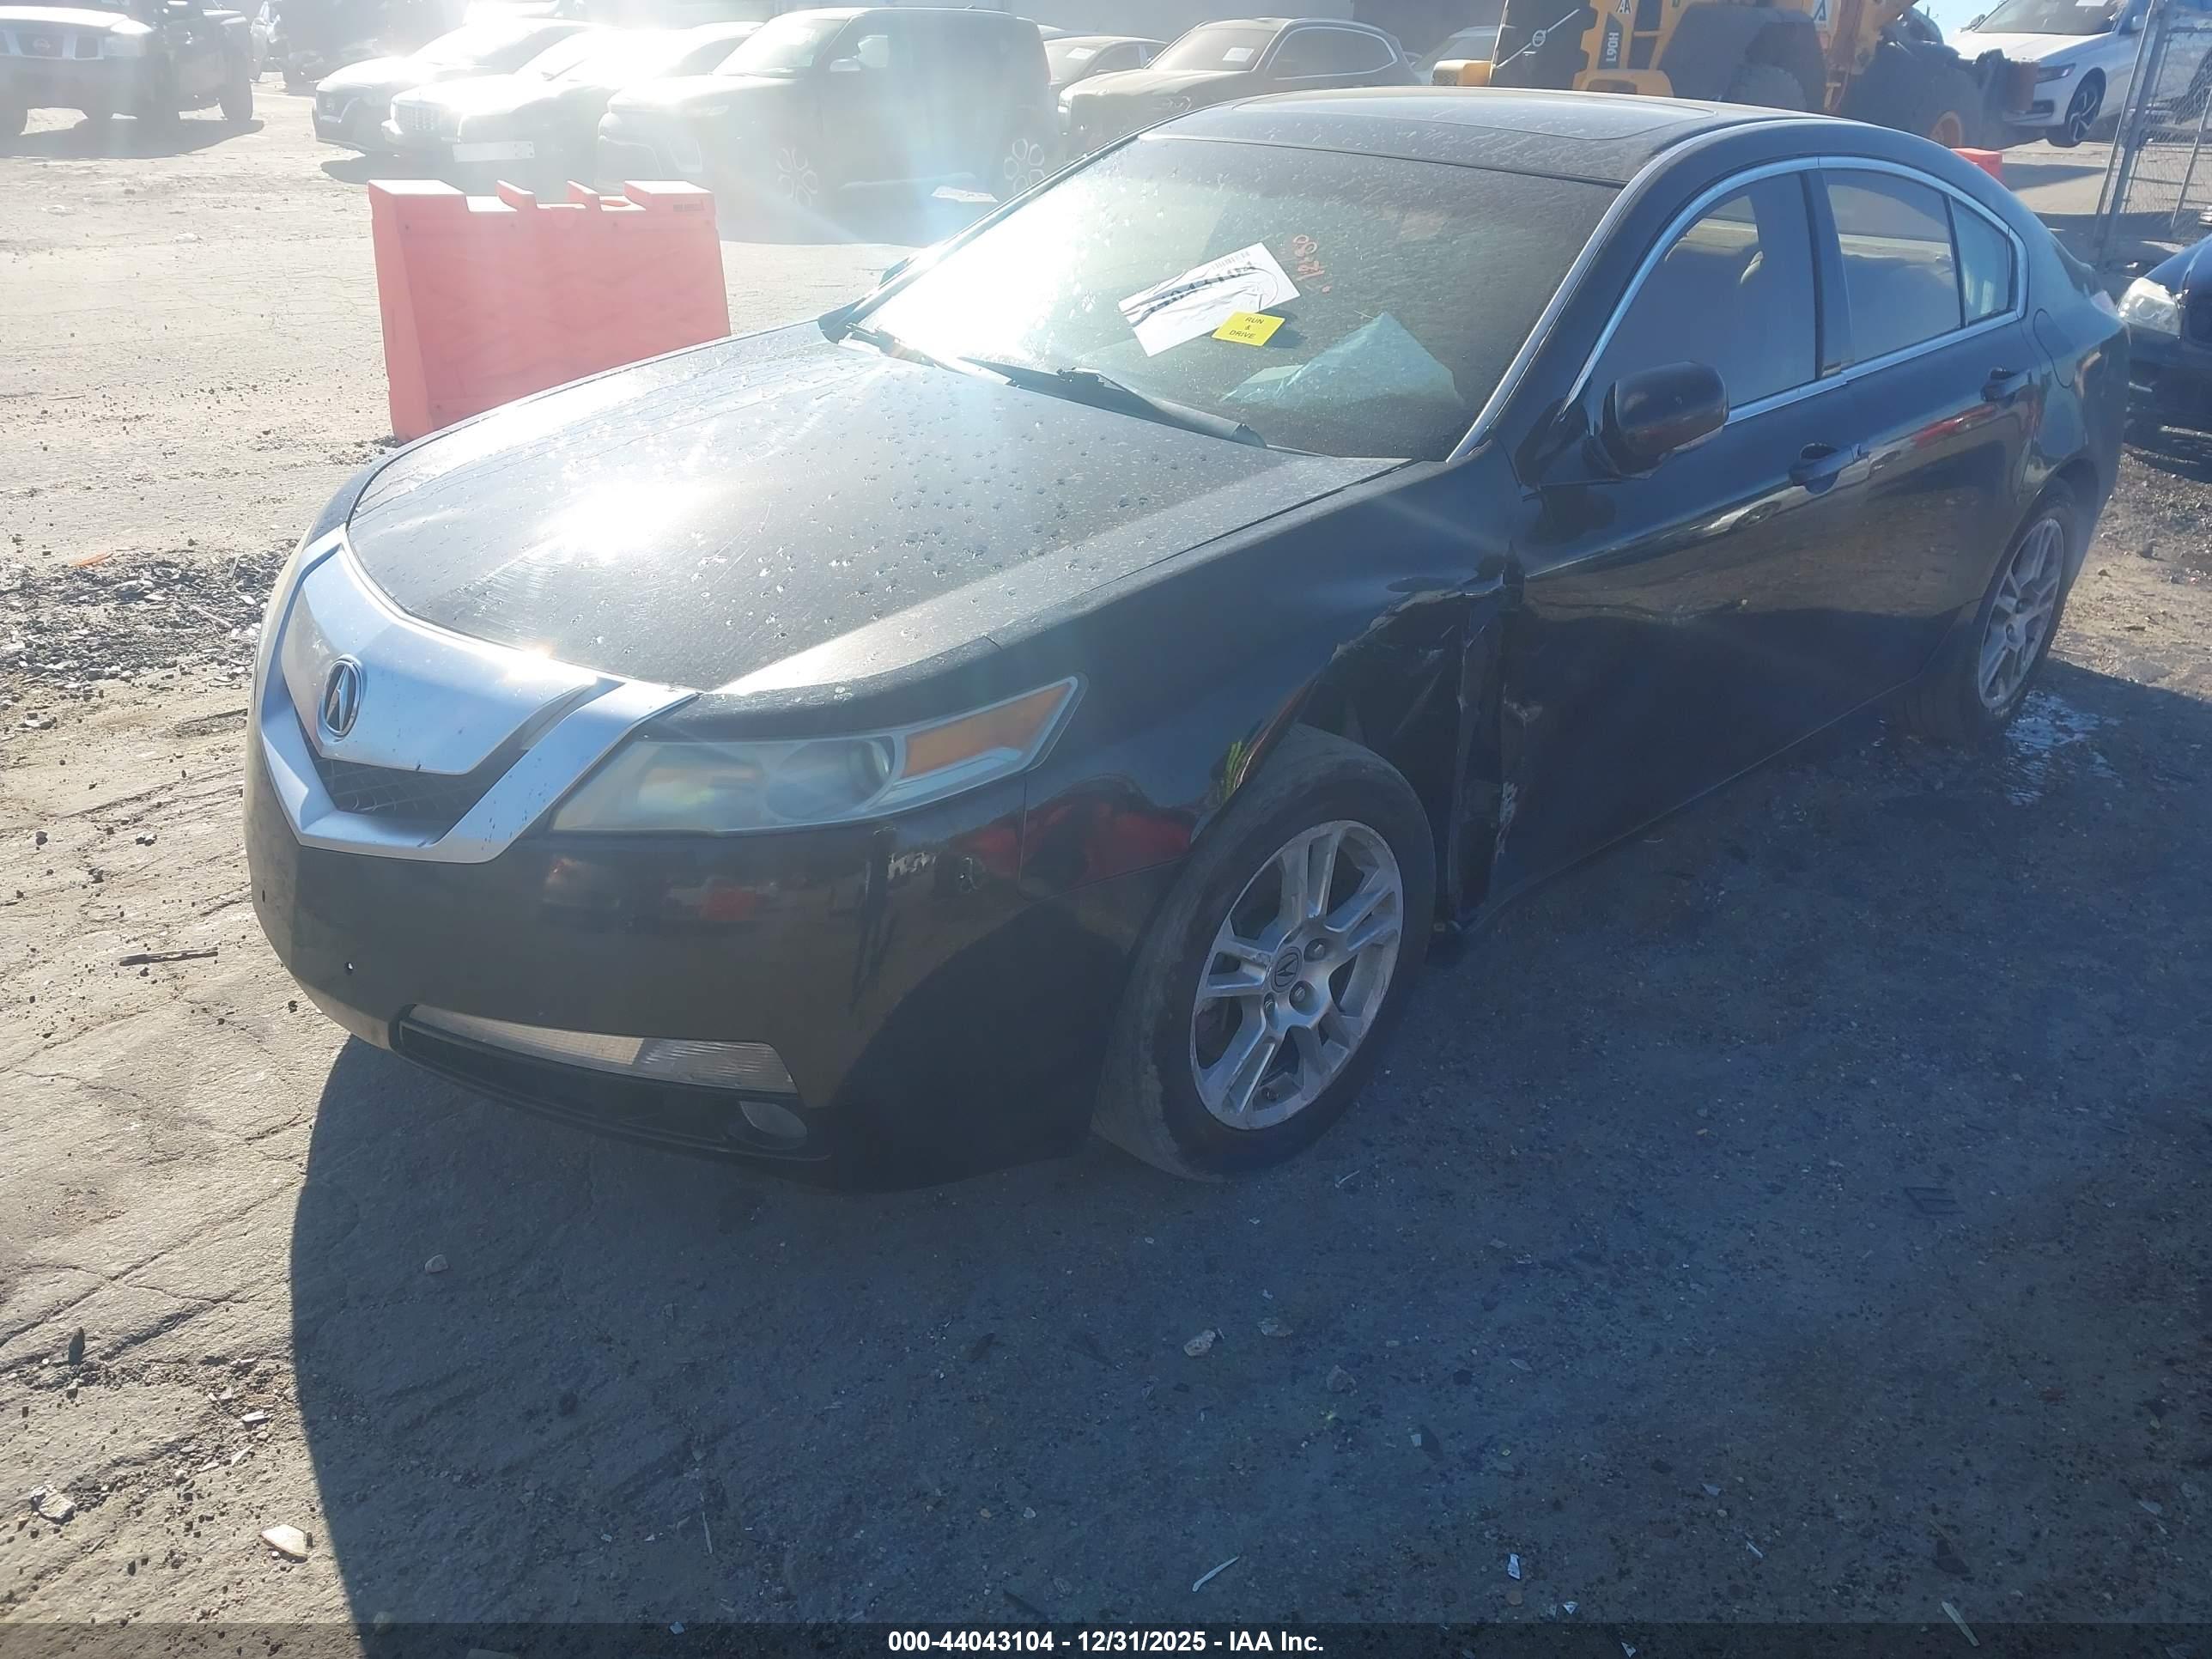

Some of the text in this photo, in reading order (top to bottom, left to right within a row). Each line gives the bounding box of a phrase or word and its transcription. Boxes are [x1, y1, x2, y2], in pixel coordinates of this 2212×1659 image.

[1606, 32, 1620, 62] L90H
[1244, 316, 1265, 325] RUN
[1229, 329, 1256, 339] DRIVE
